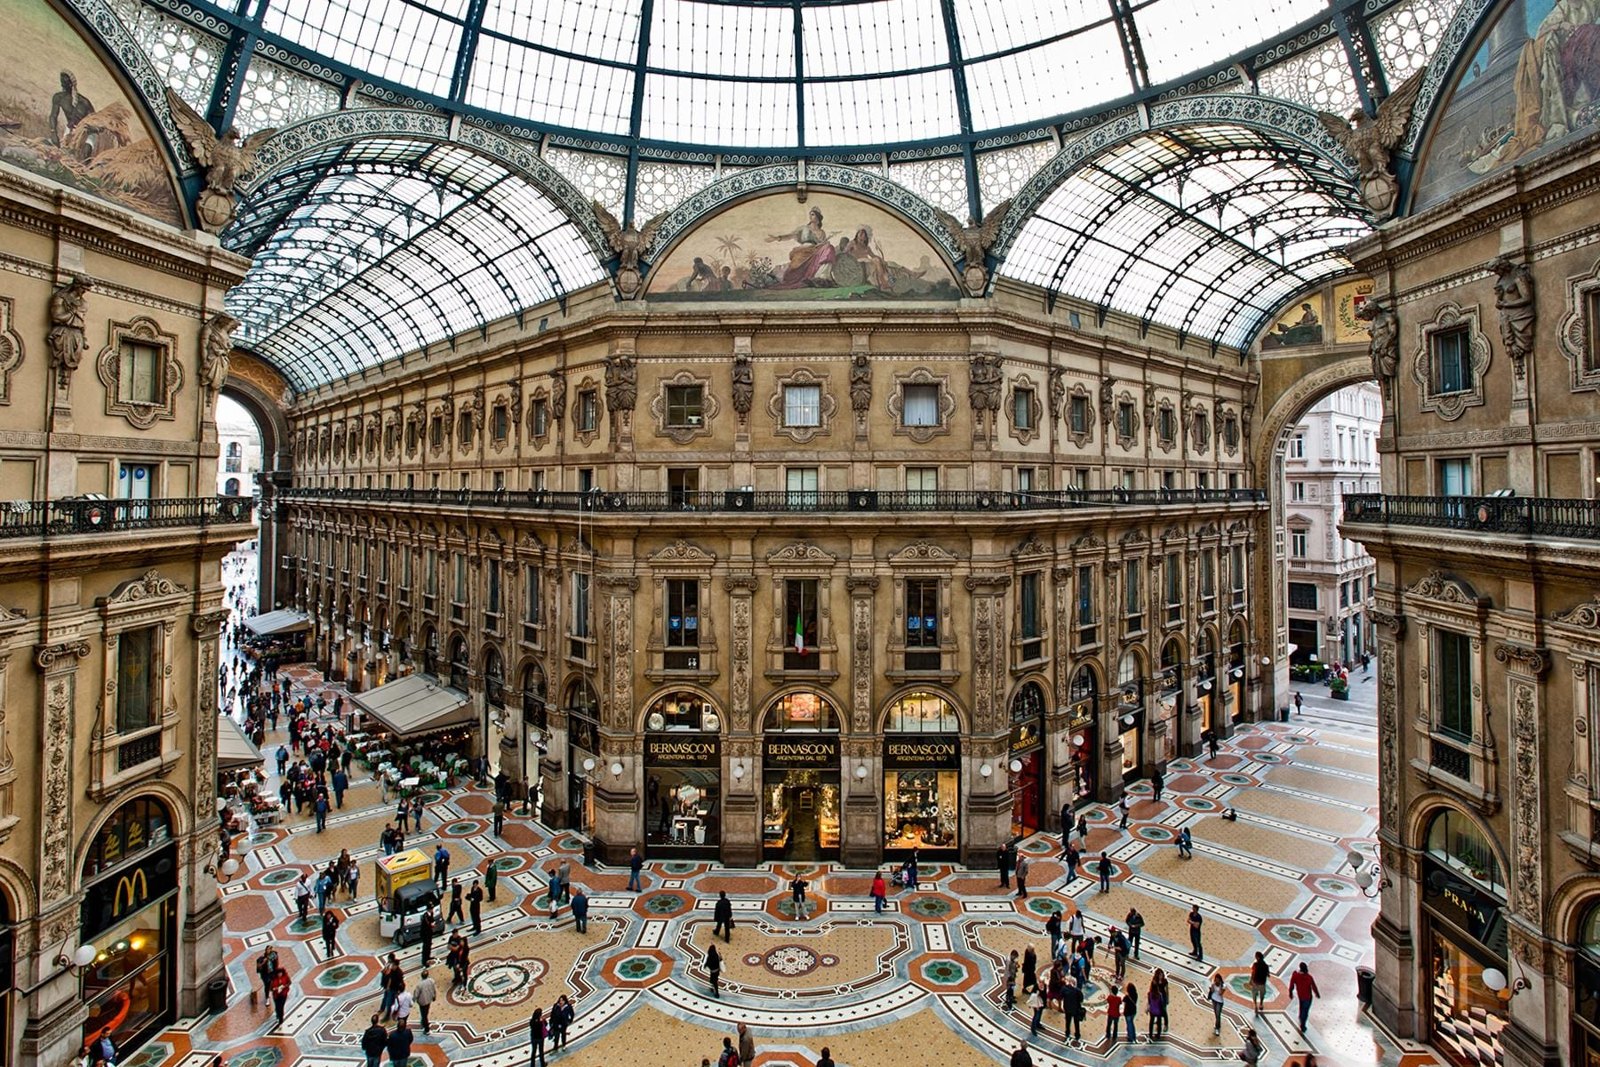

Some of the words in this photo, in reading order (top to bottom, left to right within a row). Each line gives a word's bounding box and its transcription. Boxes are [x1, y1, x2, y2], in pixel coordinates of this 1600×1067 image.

[650, 743, 715, 754] BERNASCONI
[768, 744, 835, 755] BERNASCONI
[888, 744, 955, 755] BERNASCONI
